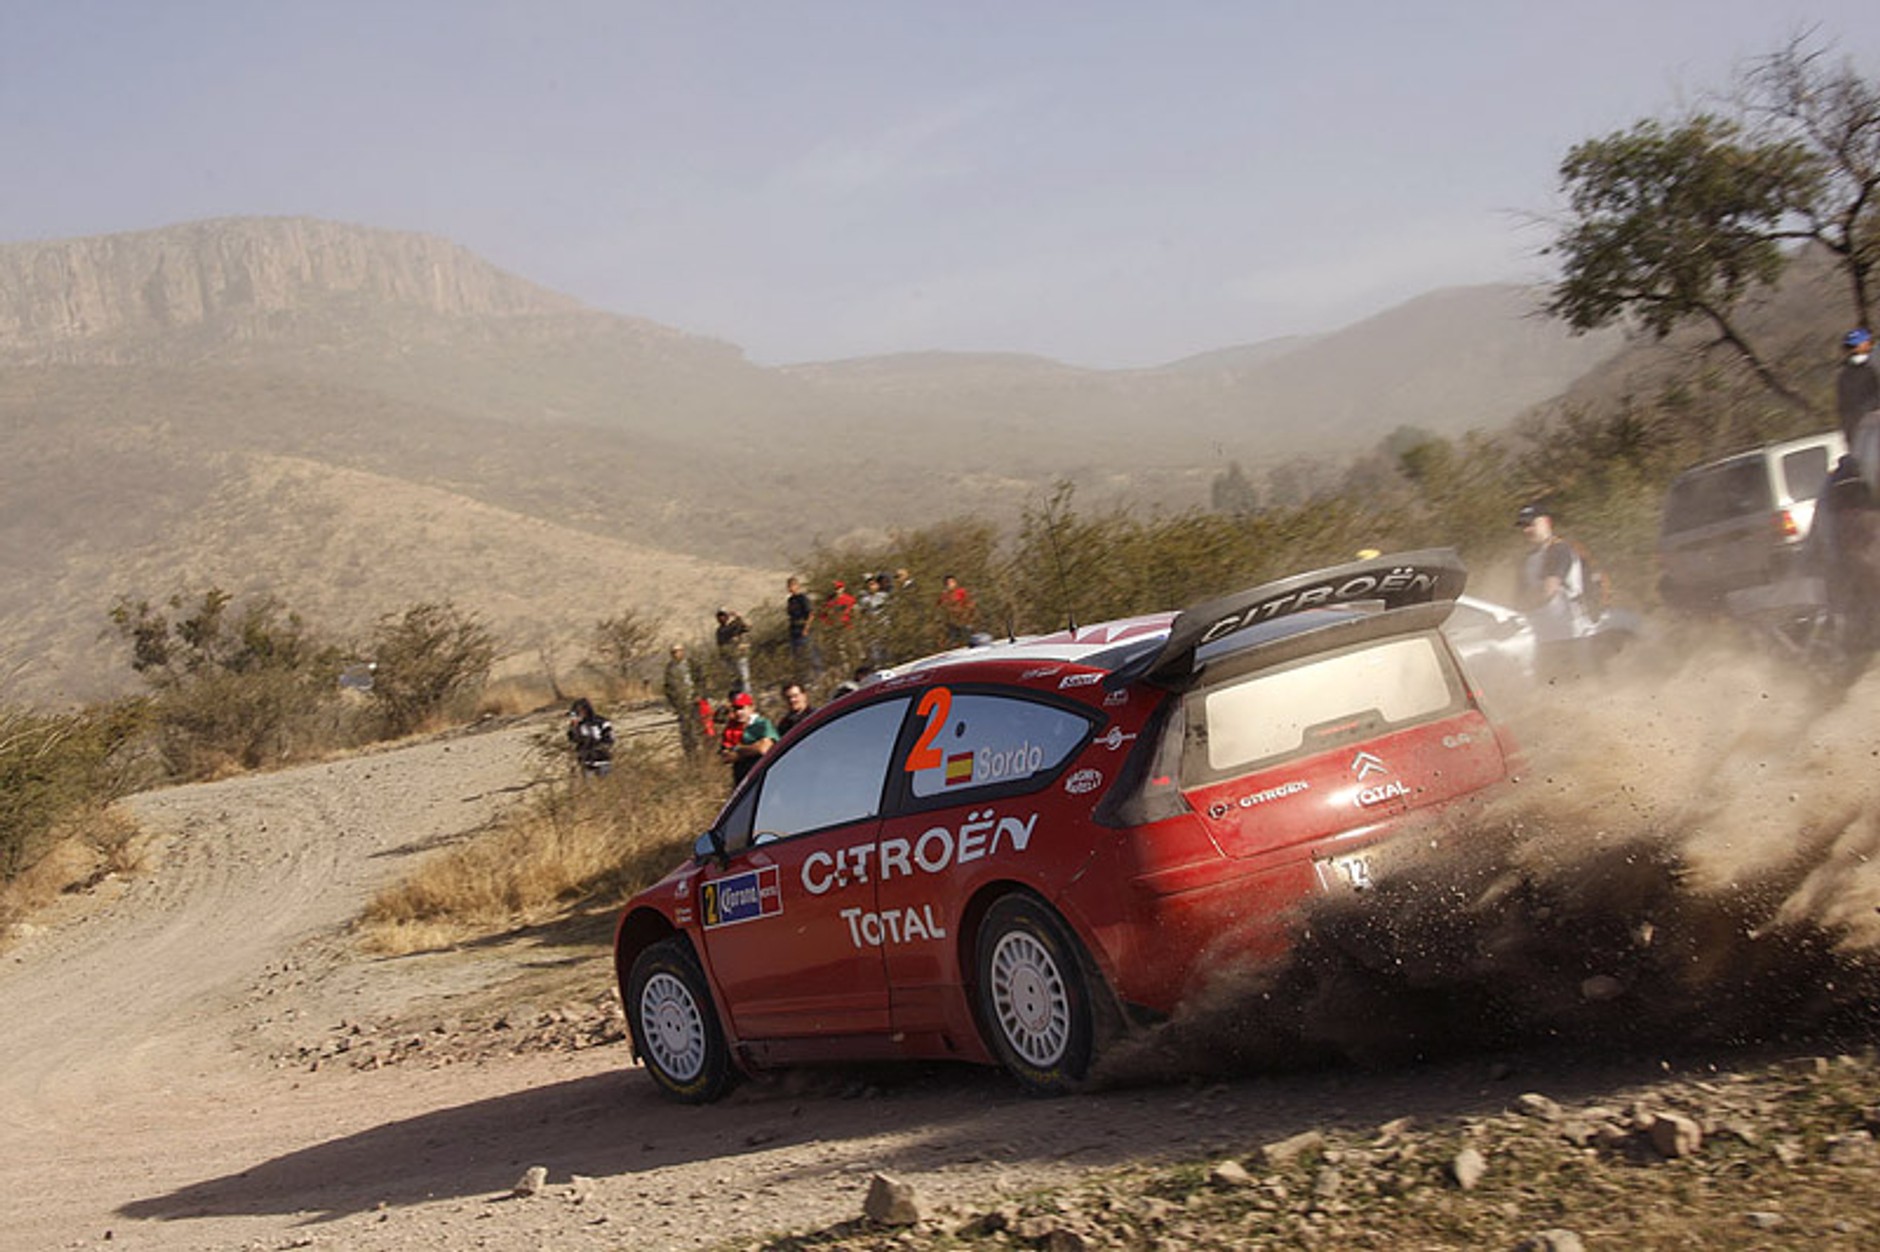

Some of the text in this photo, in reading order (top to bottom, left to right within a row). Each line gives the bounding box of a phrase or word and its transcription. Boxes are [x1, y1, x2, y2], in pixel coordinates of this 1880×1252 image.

[1201, 567, 1439, 643] CITROËN
[904, 686, 953, 772] 2
[977, 739, 1043, 780] Sordo
[801, 808, 1039, 896] CITROËN
[704, 885, 718, 925] 2
[840, 904, 946, 949] TOTAL
